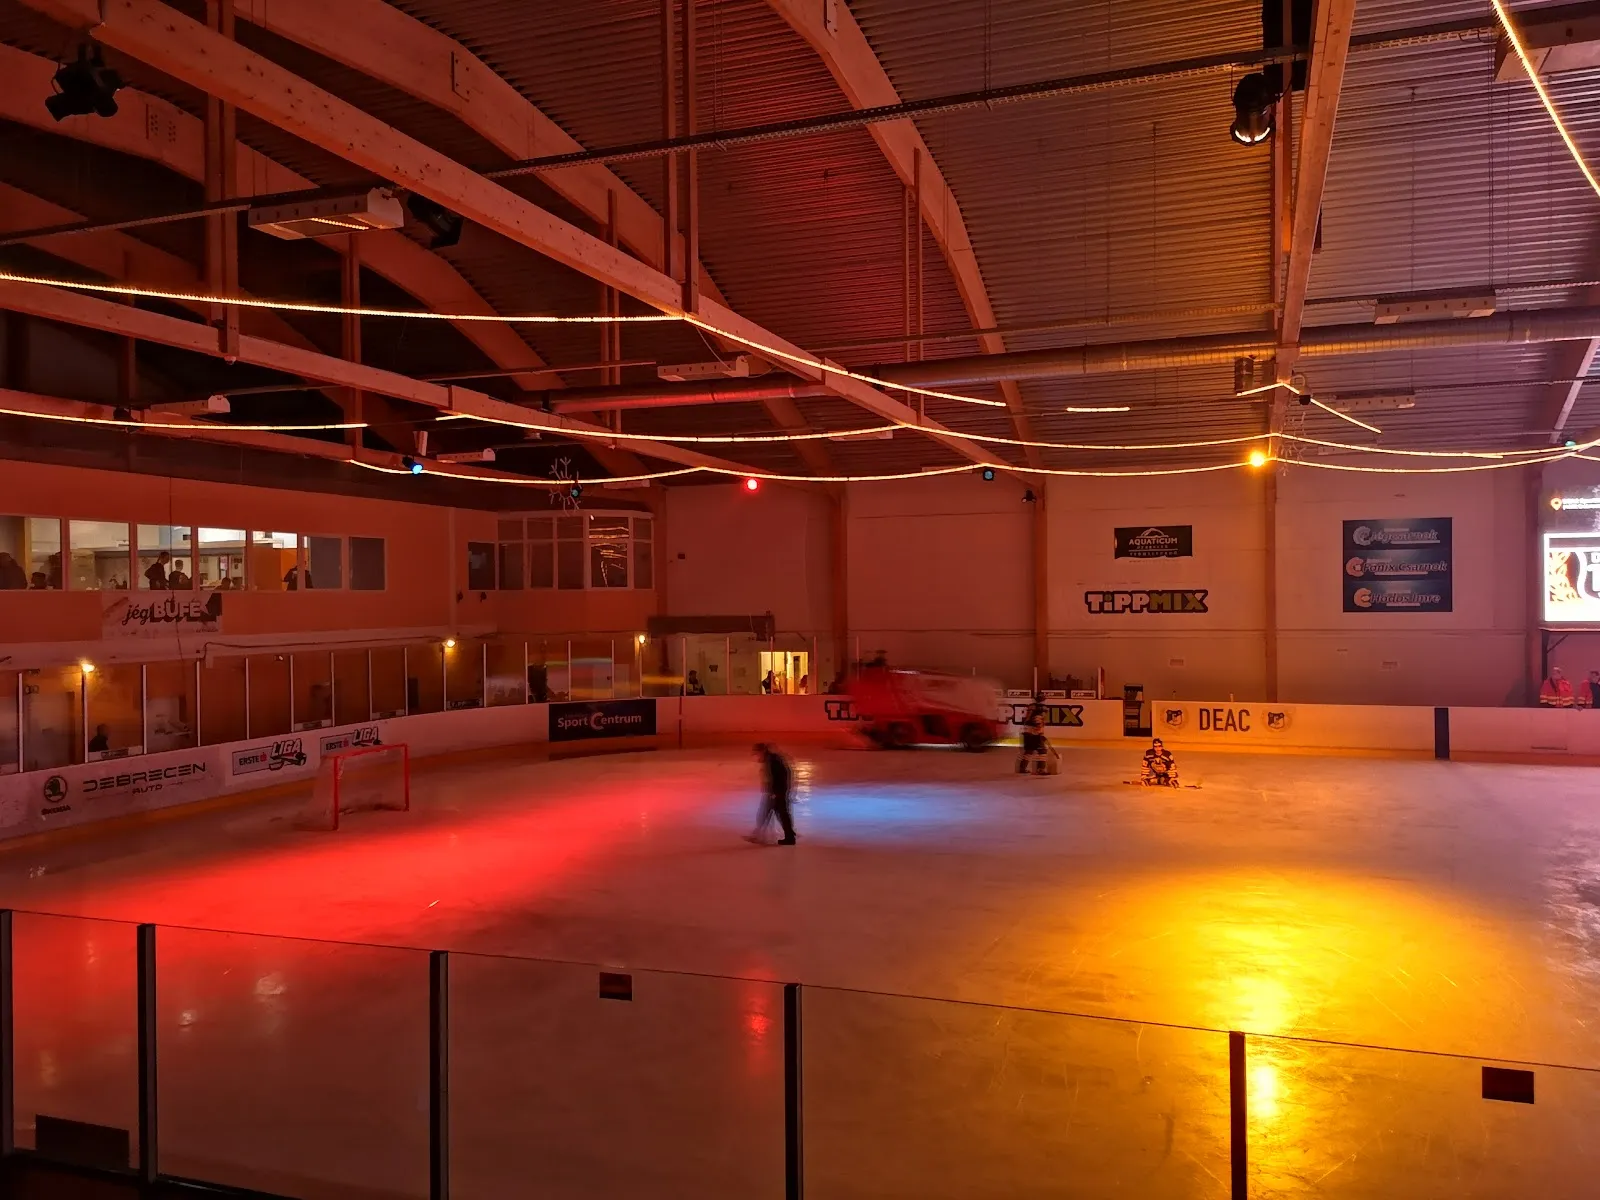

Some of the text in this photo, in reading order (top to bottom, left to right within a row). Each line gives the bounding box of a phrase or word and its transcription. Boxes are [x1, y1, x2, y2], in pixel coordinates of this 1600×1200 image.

[557, 711, 642, 731] Sport Centrum
[1199, 708, 1251, 732] DEAC
[353, 726, 379, 743] LIGA
[239, 738, 302, 766] ERSTE LIGA
[82, 762, 206, 793] DEBRECEN
[131, 784, 163, 796] AUTO
